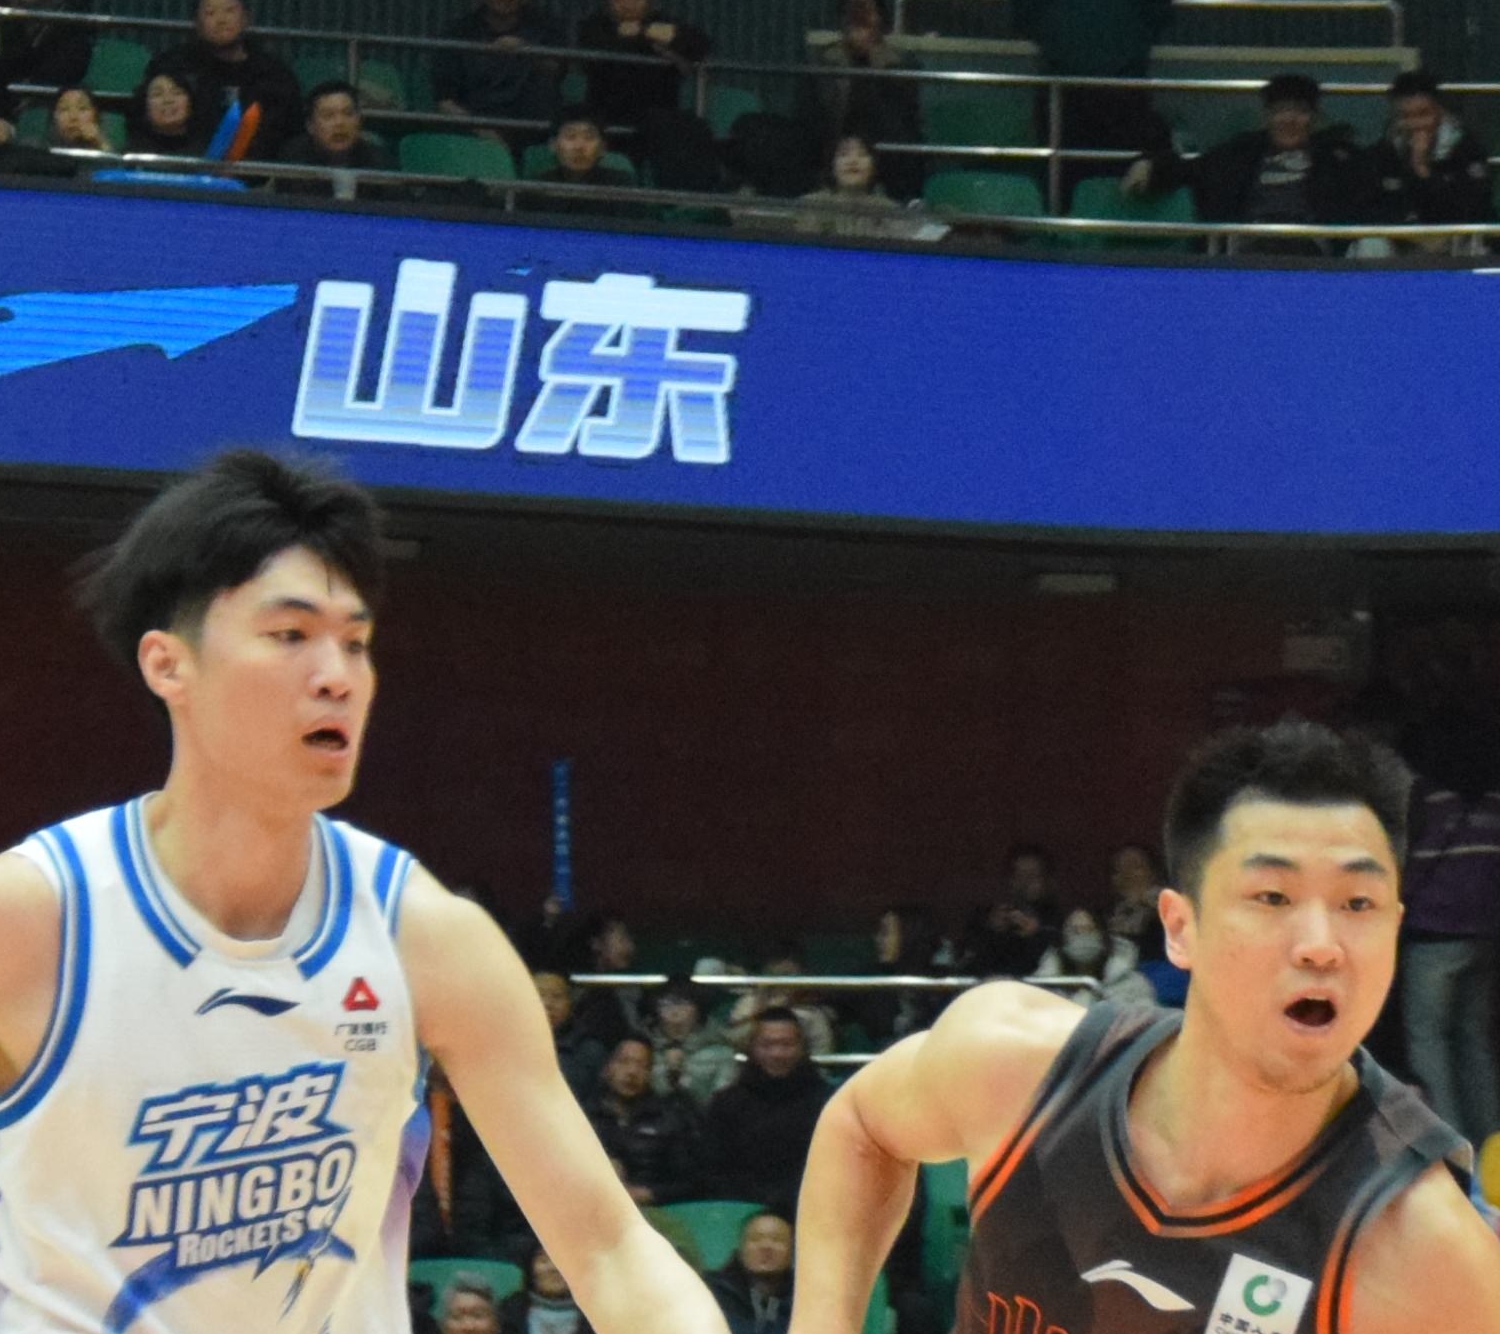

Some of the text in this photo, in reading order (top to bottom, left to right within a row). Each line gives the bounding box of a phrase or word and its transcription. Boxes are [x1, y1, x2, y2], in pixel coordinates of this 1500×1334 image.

[292, 257, 750, 464] 山东
[137, 1071, 338, 1165] 宁波
[127, 1143, 354, 1242] NINGBO
[175, 1210, 308, 1269] ROCKETS
